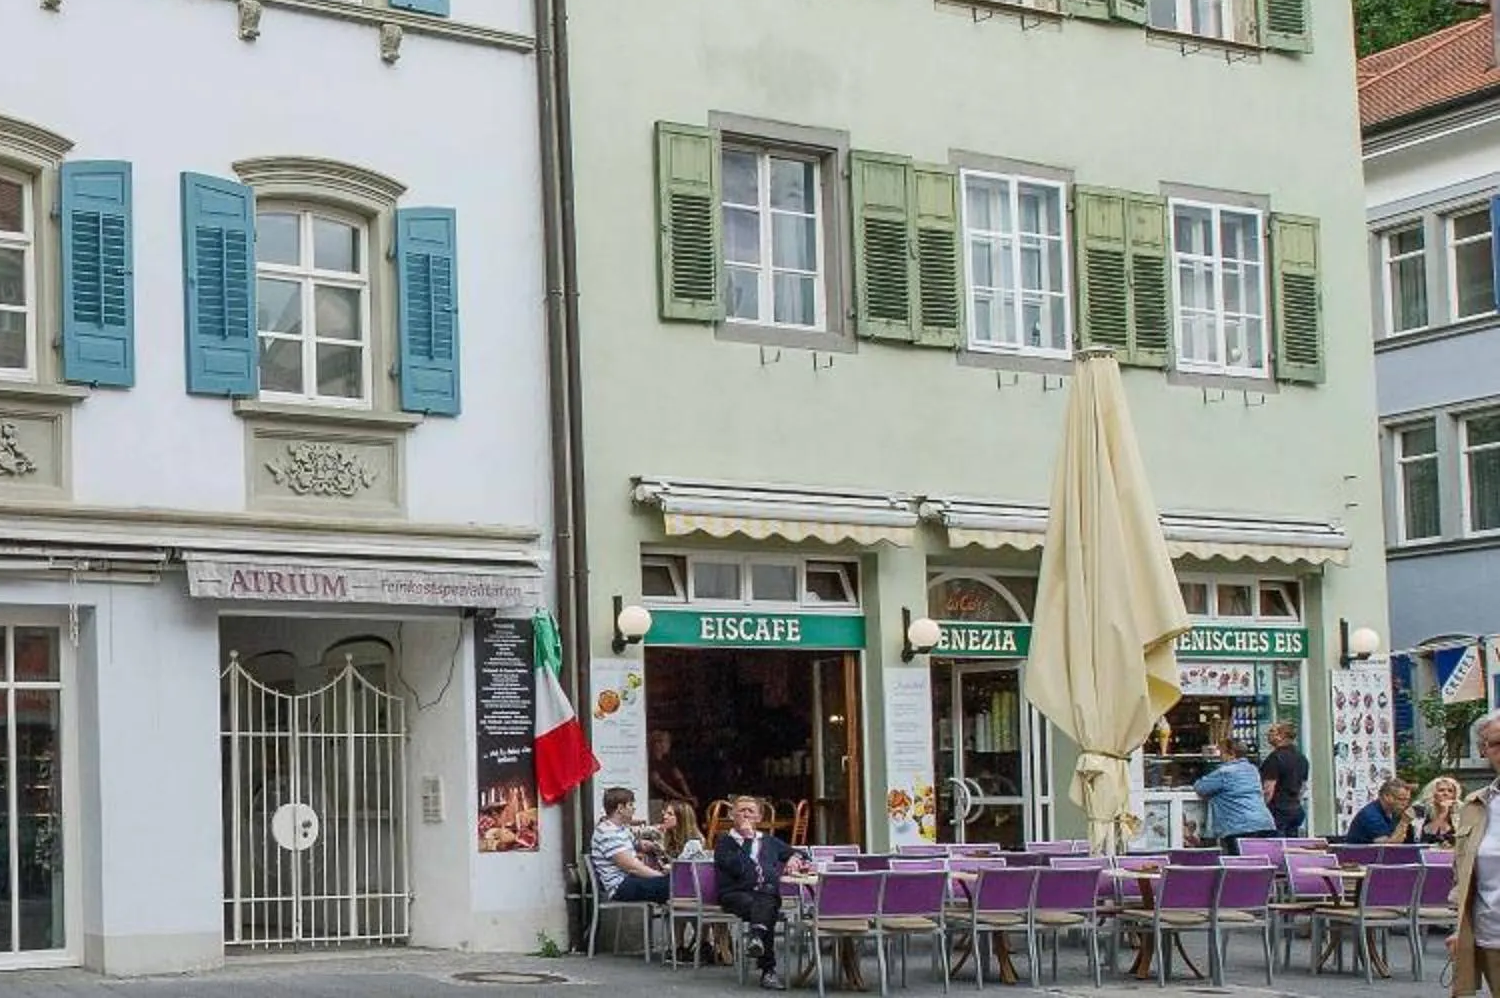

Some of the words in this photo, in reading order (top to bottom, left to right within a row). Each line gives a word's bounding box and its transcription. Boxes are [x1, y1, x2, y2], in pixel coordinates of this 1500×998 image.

[230, 569, 347, 597] ATRIUM
[700, 616, 802, 642] EISCAFE
[937, 627, 1018, 652] ENEZIA
[1275, 632, 1304, 653] EIS
